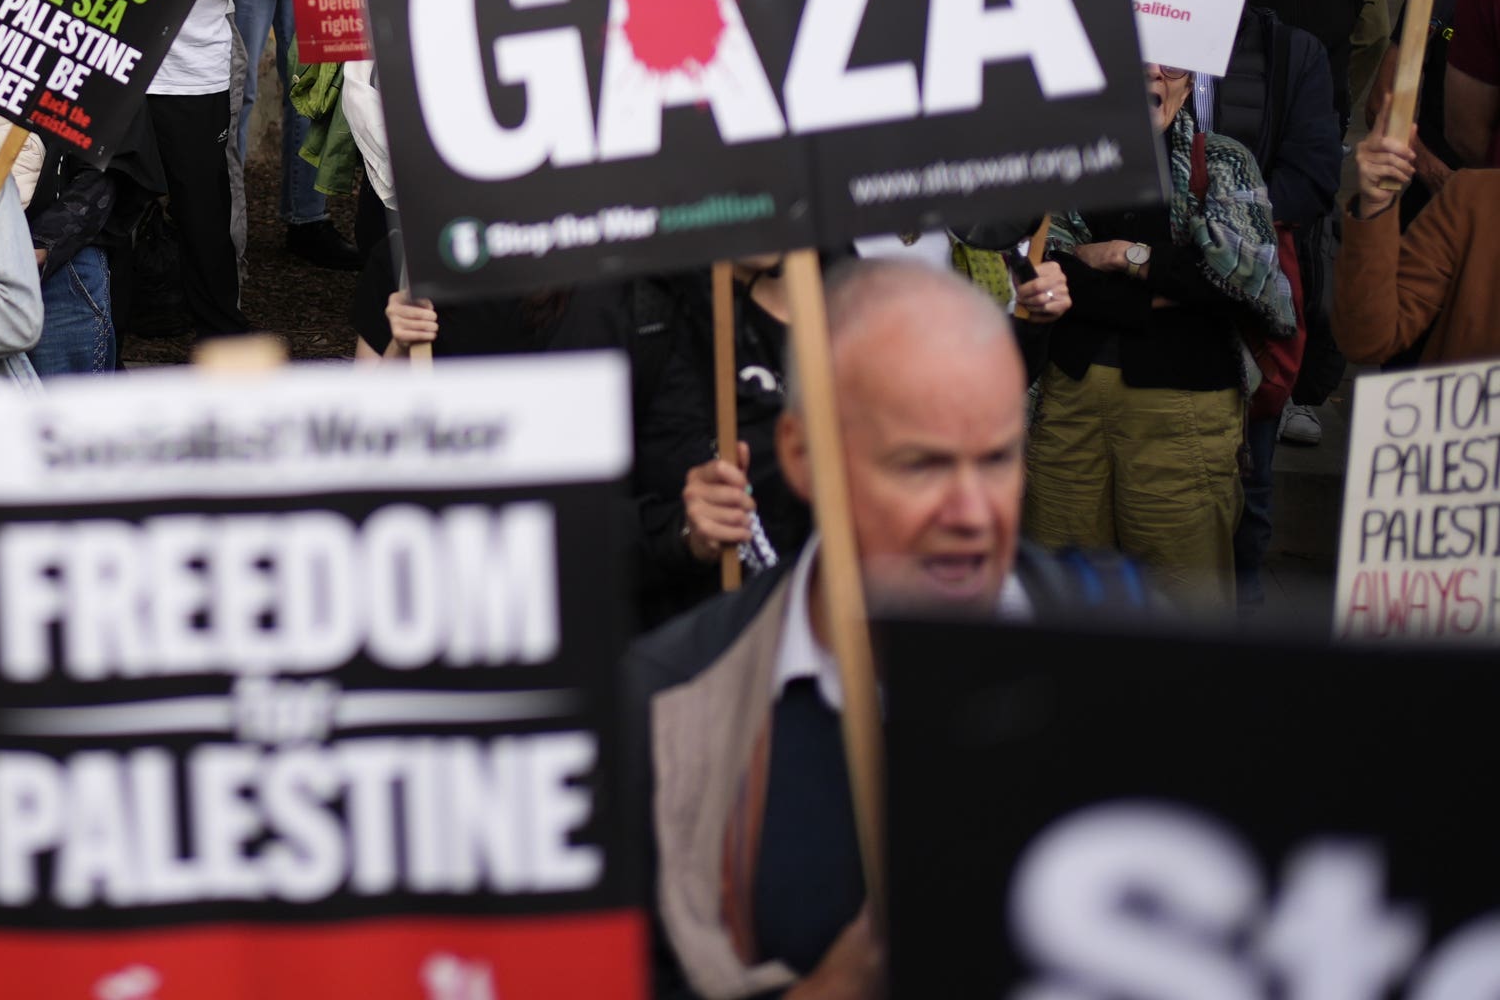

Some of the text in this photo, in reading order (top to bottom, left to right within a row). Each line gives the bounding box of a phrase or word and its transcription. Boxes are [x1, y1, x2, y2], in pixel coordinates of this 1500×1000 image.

[321, 15, 365, 37] rights
[45, 55, 92, 101] BE
[39, 90, 71, 119] Back
[70, 103, 93, 128] the
[29, 109, 93, 150] resistance
